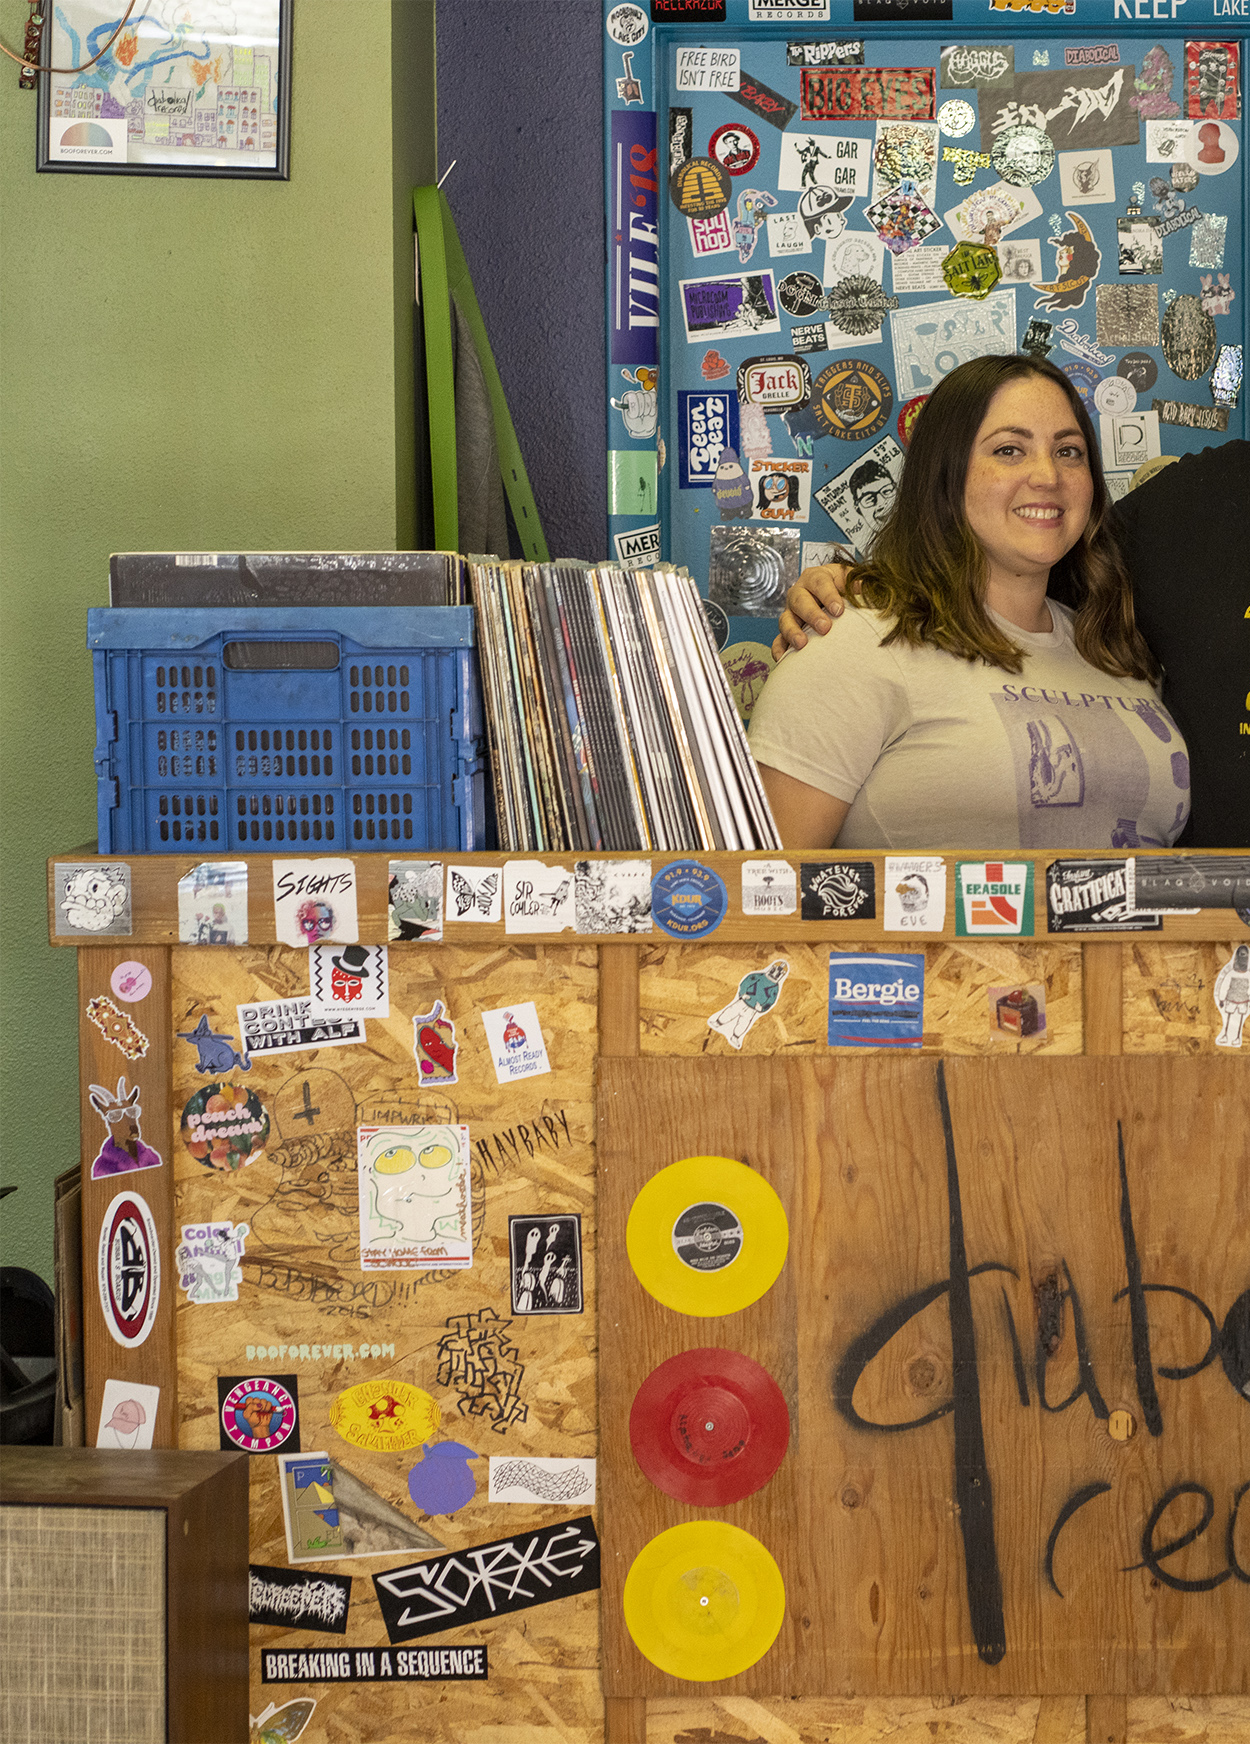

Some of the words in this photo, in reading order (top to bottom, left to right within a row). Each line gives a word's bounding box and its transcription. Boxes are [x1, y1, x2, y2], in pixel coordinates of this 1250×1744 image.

[757, 11, 824, 19] RECORDS
[1114, 0, 1187, 19] KEEP
[1213, 0, 1249, 16] LAKE
[612, 28, 630, 44] LAKE
[631, 26, 646, 43] CITY
[679, 51, 706, 67] FREE
[709, 53, 737, 67] BIRD
[1066, 45, 1119, 64] DIABOLICAL
[679, 69, 706, 86] ISN'T
[709, 70, 735, 88] FREE
[808, 76, 851, 111] BIG
[859, 76, 928, 111] EYES
[836, 141, 858, 159] GAR
[677, 160, 700, 188] DIABOLICAL
[700, 160, 723, 182] RECORDS
[834, 167, 856, 185] GAR
[773, 214, 797, 224] LAST
[1154, 206, 1202, 240] DIABOLICAL
[942, 260, 971, 283] SALT
[790, 325, 824, 337] NERVE
[792, 334, 826, 345] BEATS
[1056, 319, 1115, 363] Diabolical
[751, 369, 800, 396] Jack
[814, 360, 854, 390] TRIGGERS
[855, 361, 875, 377] AND
[874, 371, 892, 400] SLIPS
[761, 391, 790, 400] GRELLE
[812, 403, 829, 428] SALT
[828, 424, 851, 441] LAKE
[854, 423, 877, 441] CITY
[876, 412, 889, 433] UT
[889, 446, 901, 458] LB
[751, 459, 811, 474] STICKER
[820, 480, 850, 507] SATURDAY
[827, 495, 848, 514] GIANT
[838, 508, 850, 518] HAS
[760, 507, 795, 522] GUY!
[626, 534, 660, 556] MER
[627, 552, 660, 568] RECO
[1002, 684, 1165, 716] SCULPTUR
[275, 871, 354, 902] SIGHTS
[808, 865, 861, 893] WHATEVER
[1141, 878, 1184, 886] BLAQ
[515, 880, 533, 901] SIR
[671, 893, 703, 906] KDUR
[753, 894, 785, 907] ROOTS
[822, 888, 870, 917] FOREVER
[666, 918, 709, 932] KDUR.ORG
[900, 916, 928, 927] EVE
[833, 977, 921, 1006] Bergie
[249, 1032, 302, 1050] WITH
[310, 1021, 357, 1042] ALF
[498, 1054, 522, 1068] ALMOST
[523, 1049, 544, 1065] READY
[509, 1063, 538, 1076] RECORDS
[187, 1102, 252, 1129] peach
[190, 1119, 264, 1144] dream
[475, 1108, 573, 1175] HAYBABY
[245, 1343, 396, 1361] BOOFOREVER.COM
[223, 1379, 293, 1414] VENGEANCE
[227, 1421, 293, 1451] TAMPON
[265, 1652, 351, 1680] BREAKING
[354, 1651, 376, 1678] IN
[379, 1651, 394, 1678] A
[396, 1649, 485, 1678] SEQUENCE
